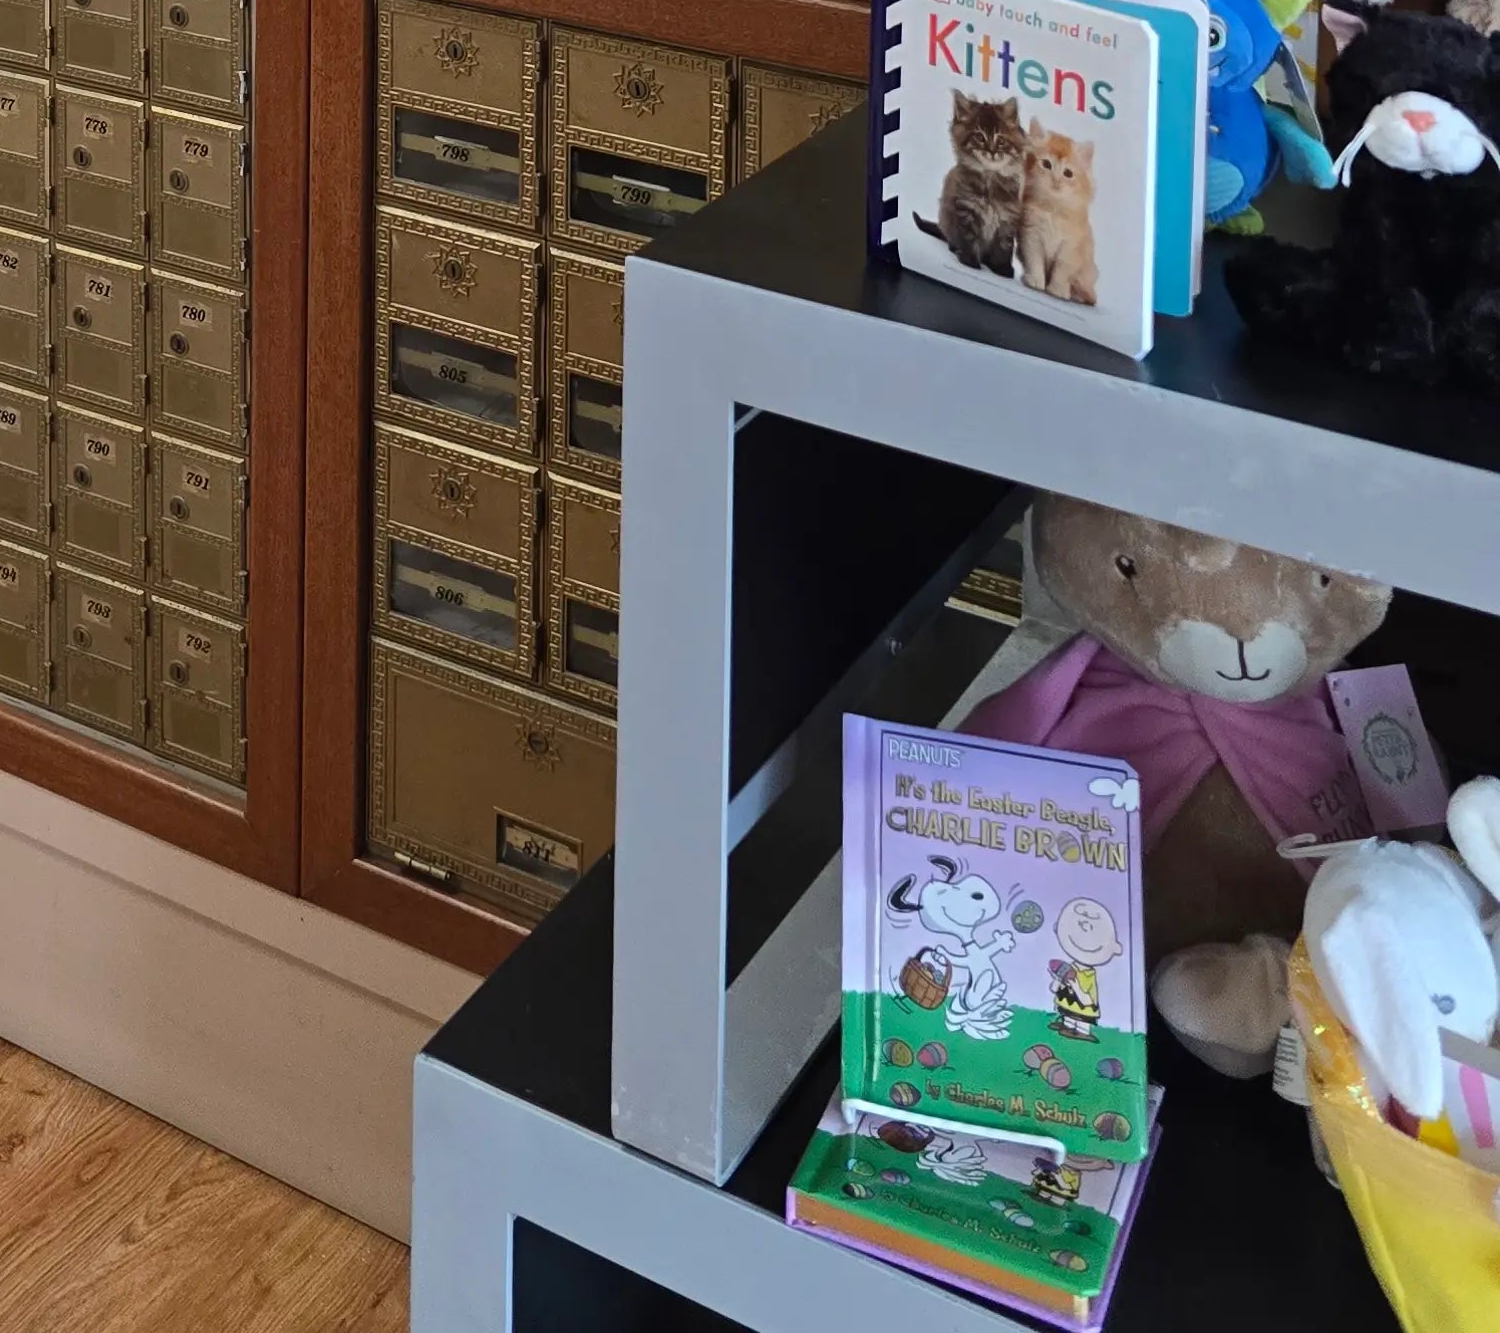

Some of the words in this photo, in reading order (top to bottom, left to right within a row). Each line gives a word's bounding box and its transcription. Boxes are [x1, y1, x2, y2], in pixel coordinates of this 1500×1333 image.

[1000, 3, 1042, 29] touch
[1049, 21, 1080, 39] and
[1085, 25, 1118, 50] feel
[928, 13, 1116, 121] Kittens
[85, 117, 107, 134] 778
[184, 140, 208, 158] 779
[441, 143, 469, 163] 798
[620, 185, 652, 206] 799
[88, 280, 112, 298] 781
[182, 305, 206, 323] 780
[438, 364, 467, 384] 805
[86, 439, 110, 457] 790
[186, 471, 209, 491] 791
[435, 585, 464, 606] 806
[86, 600, 111, 619] 793
[185, 633, 210, 653] 792
[888, 738, 961, 768] PEANUTS
[931, 781, 962, 805] the
[968, 787, 1035, 818] Easter
[1040, 797, 1116, 836] Beagle,
[886, 806, 1007, 851] CHARLIE
[1014, 826, 1128, 872] BROWN
[946, 1084, 1005, 1113] Charles
[1034, 1099, 1088, 1128] Schulz
